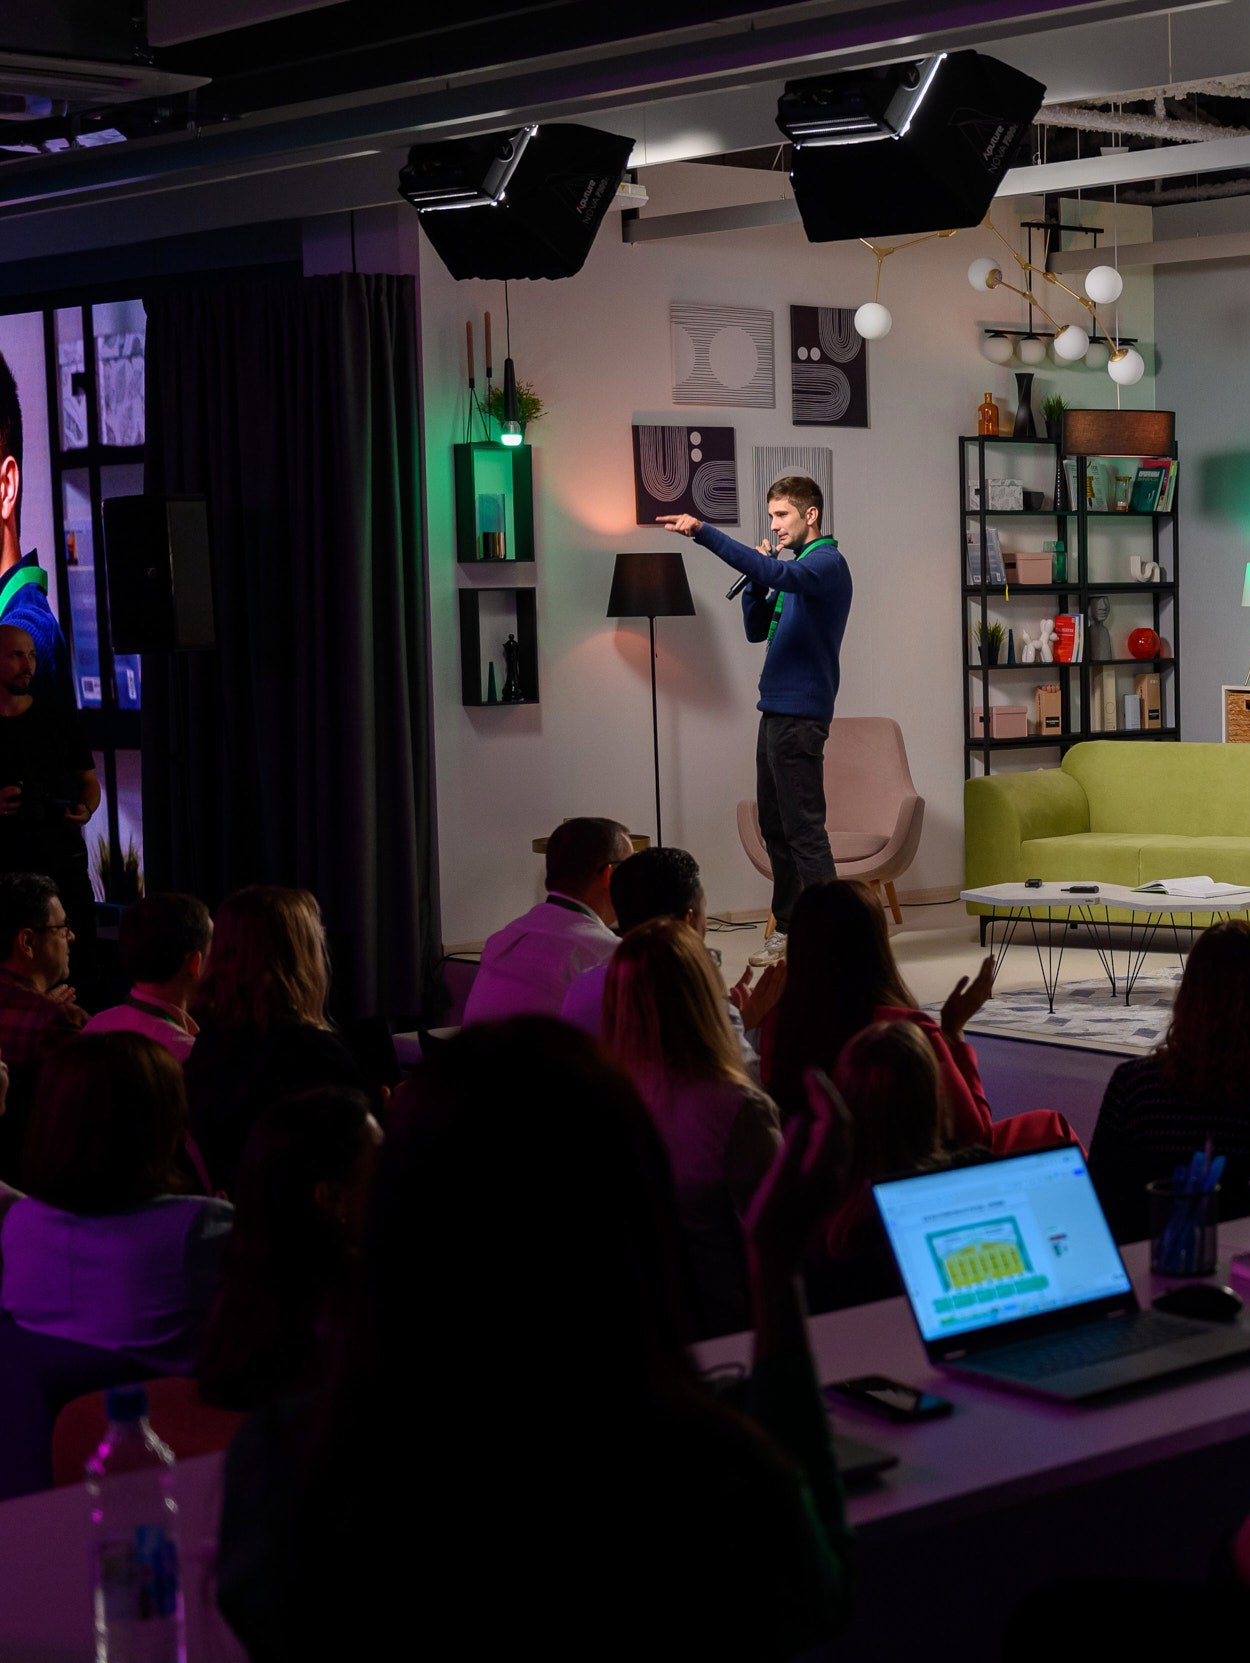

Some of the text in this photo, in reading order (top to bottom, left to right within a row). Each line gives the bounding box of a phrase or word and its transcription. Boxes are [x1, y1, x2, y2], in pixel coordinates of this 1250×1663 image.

[980, 125, 1004, 161] Aputure
[988, 146, 1008, 173] NOVA
[576, 179, 596, 214] Aputure
[582, 197, 600, 224] NOVA
